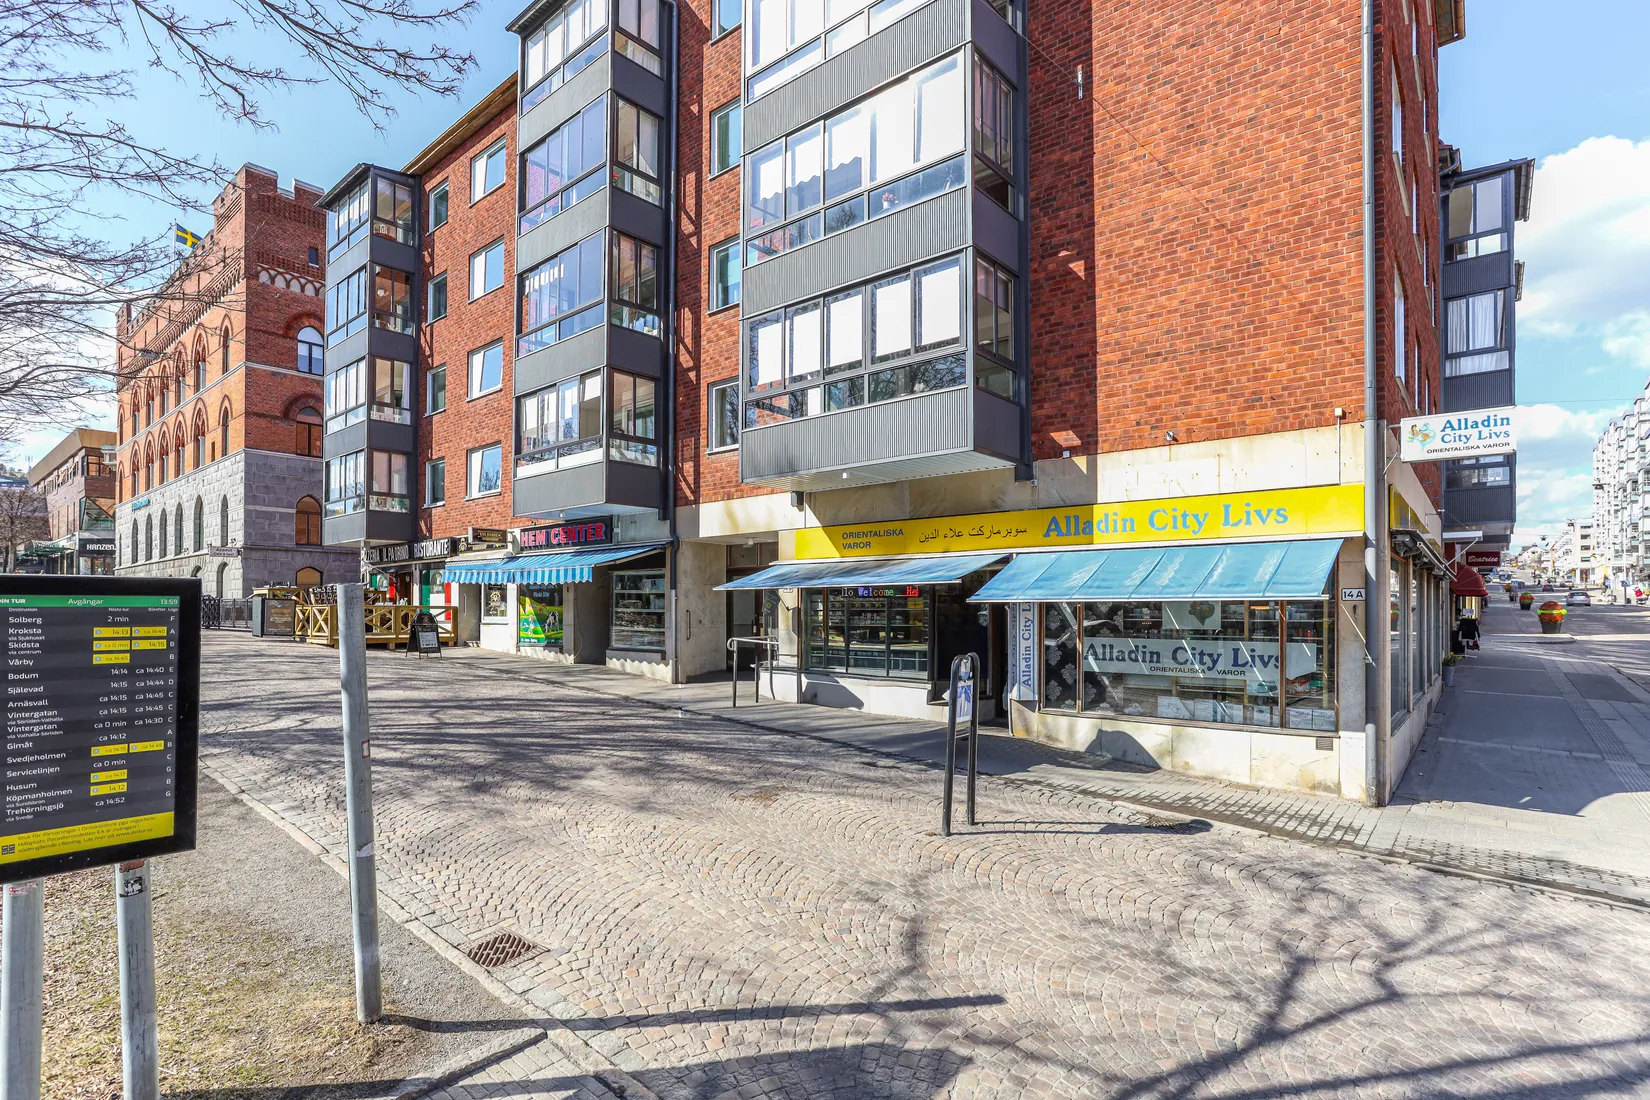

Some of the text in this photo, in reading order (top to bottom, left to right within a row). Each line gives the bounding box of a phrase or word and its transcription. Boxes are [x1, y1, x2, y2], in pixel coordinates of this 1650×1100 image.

[1440, 414, 1510, 432] Alladin
[1441, 429, 1510, 444] City Livs
[1426, 445, 1480, 454] ORIENTALISKA
[1043, 502, 1288, 538] Alladin City Livs
[521, 530, 546, 547] HEM
[551, 523, 605, 544] CENTER
[842, 528, 904, 540] ORIENTALISKA
[919, 529, 939, 543] الدين
[944, 528, 963, 539] علاء
[413, 539, 448, 558] RISTORANTE
[858, 587, 894, 596] Welcome
[1022, 617, 1033, 641] City
[1084, 642, 1161, 663] Alladin
[1172, 646, 1222, 671] City
[1022, 646, 1031, 687] Alladin
[8, 686, 44, 694] Själevad
[8, 699, 48, 707] Arnäsvall
[8, 710, 57, 718] Vintergatan
[8, 724, 57, 732] Vintergatan
[7, 752, 66, 763] Svedjeholmen
[7, 767, 60, 777] Servicelinjen
[7, 783, 37, 791] Husum
[7, 789, 72, 802] Köpmanholmen
[6, 802, 64, 815] Trehörningsjö
